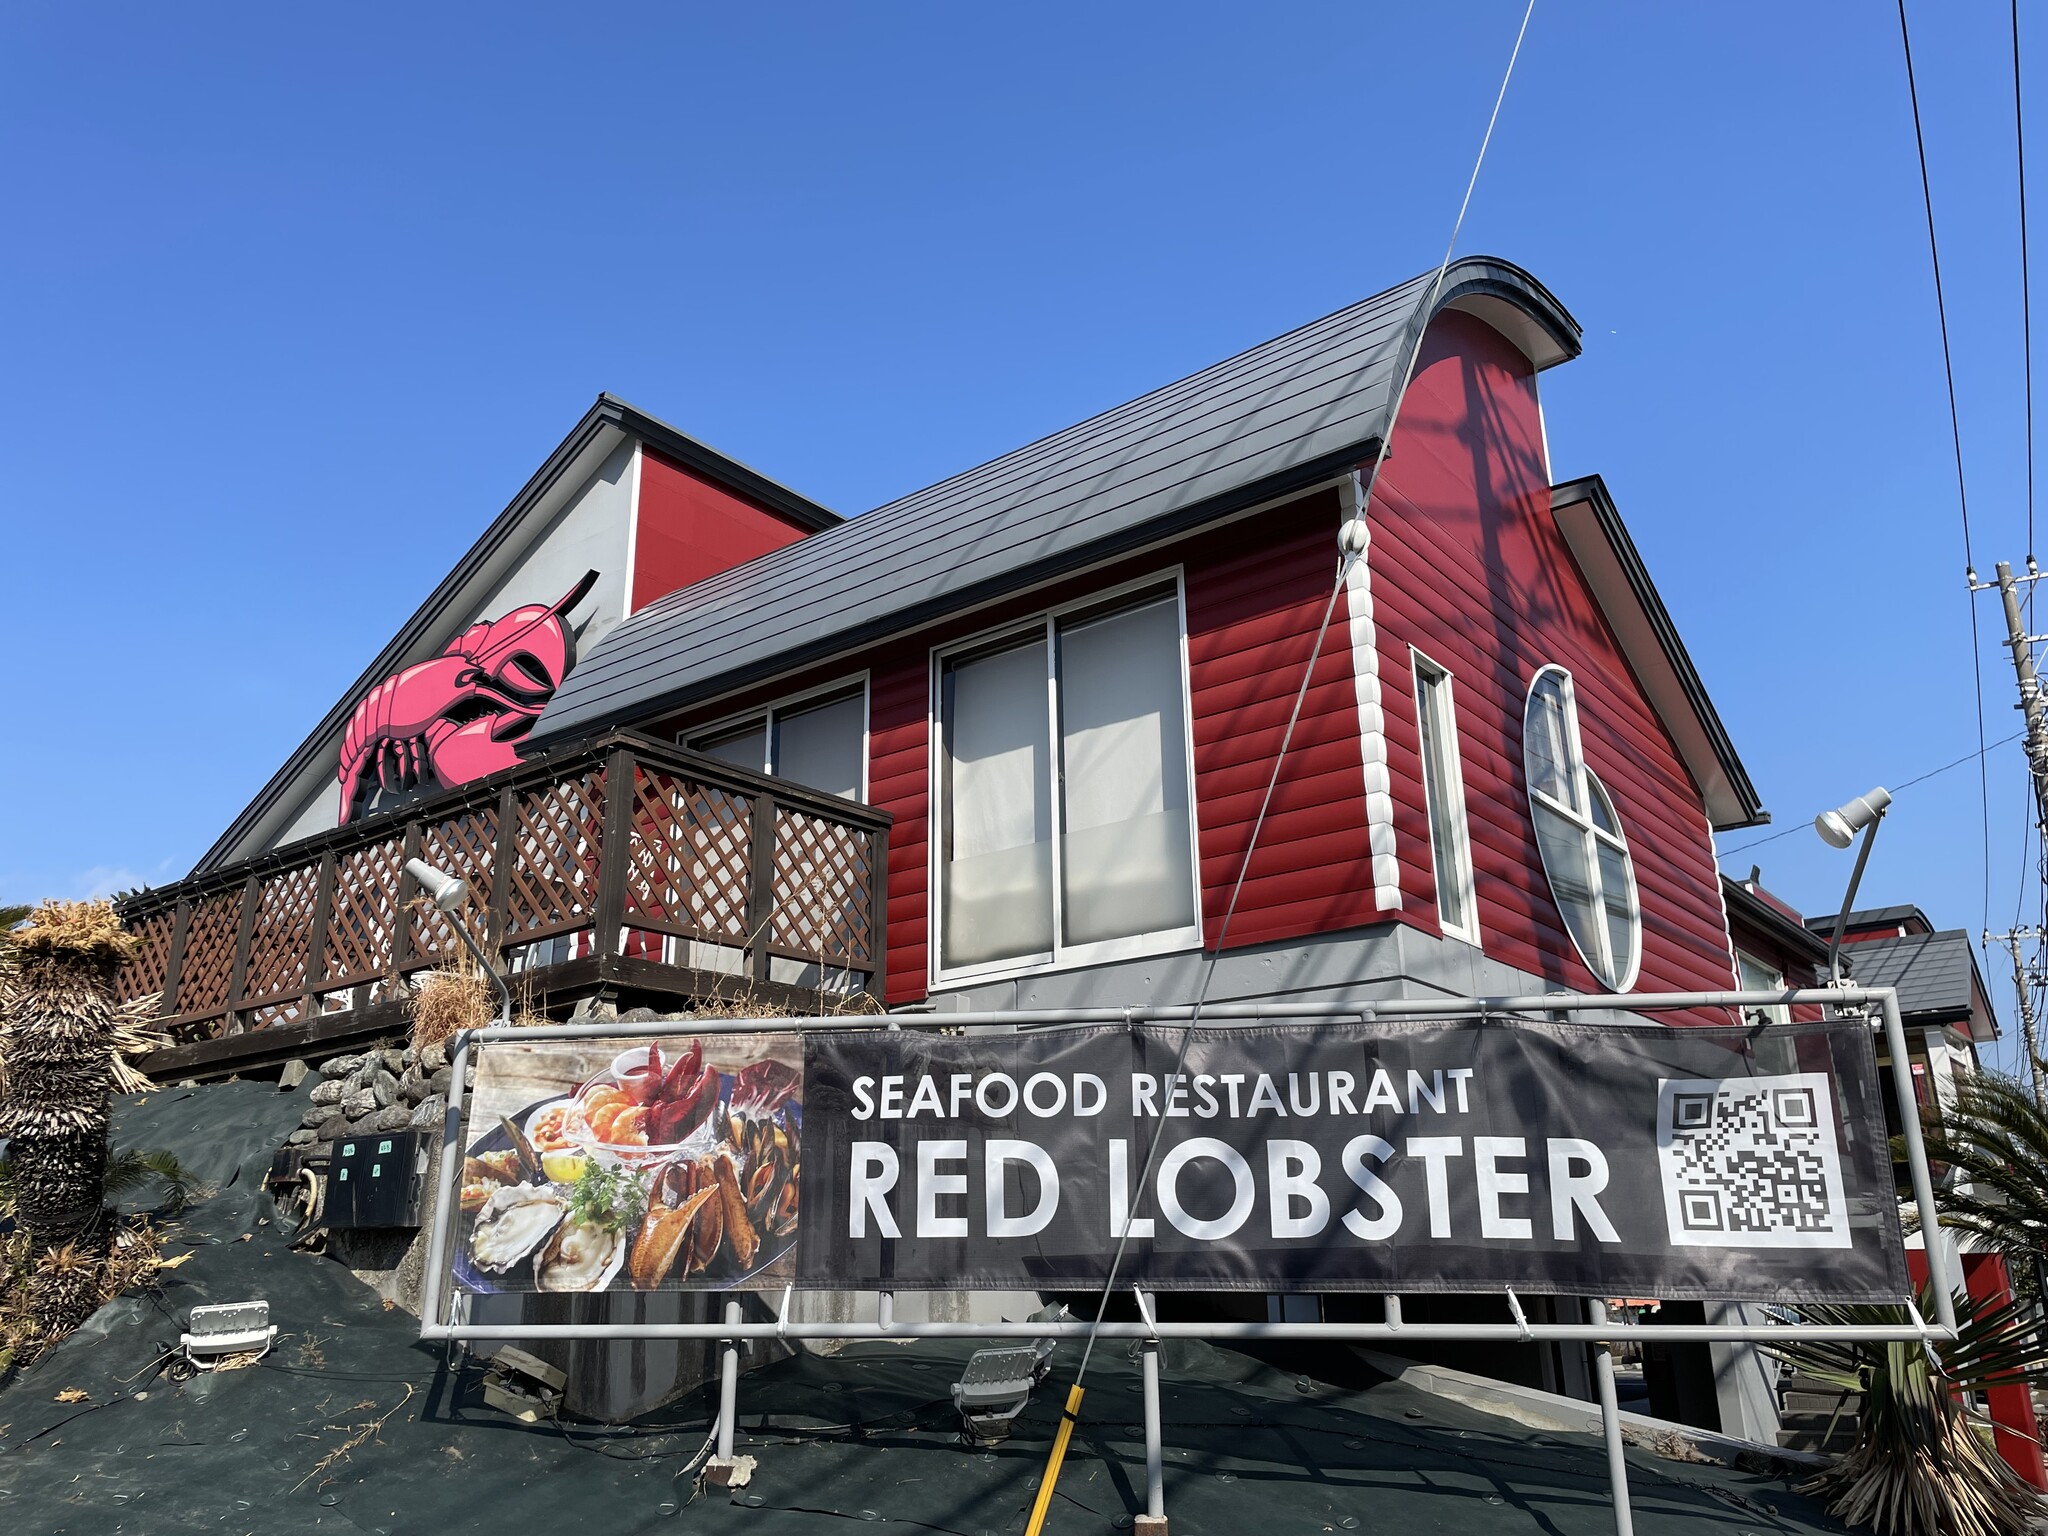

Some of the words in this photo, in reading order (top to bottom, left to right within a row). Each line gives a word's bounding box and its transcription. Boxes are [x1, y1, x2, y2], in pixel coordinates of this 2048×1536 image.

[850, 1071, 1108, 1121] SEAFOOD
[1131, 1067, 1474, 1119] RESTAURANT
[848, 1138, 1061, 1239] RED
[1108, 1134, 1623, 1243] LOBSTER
